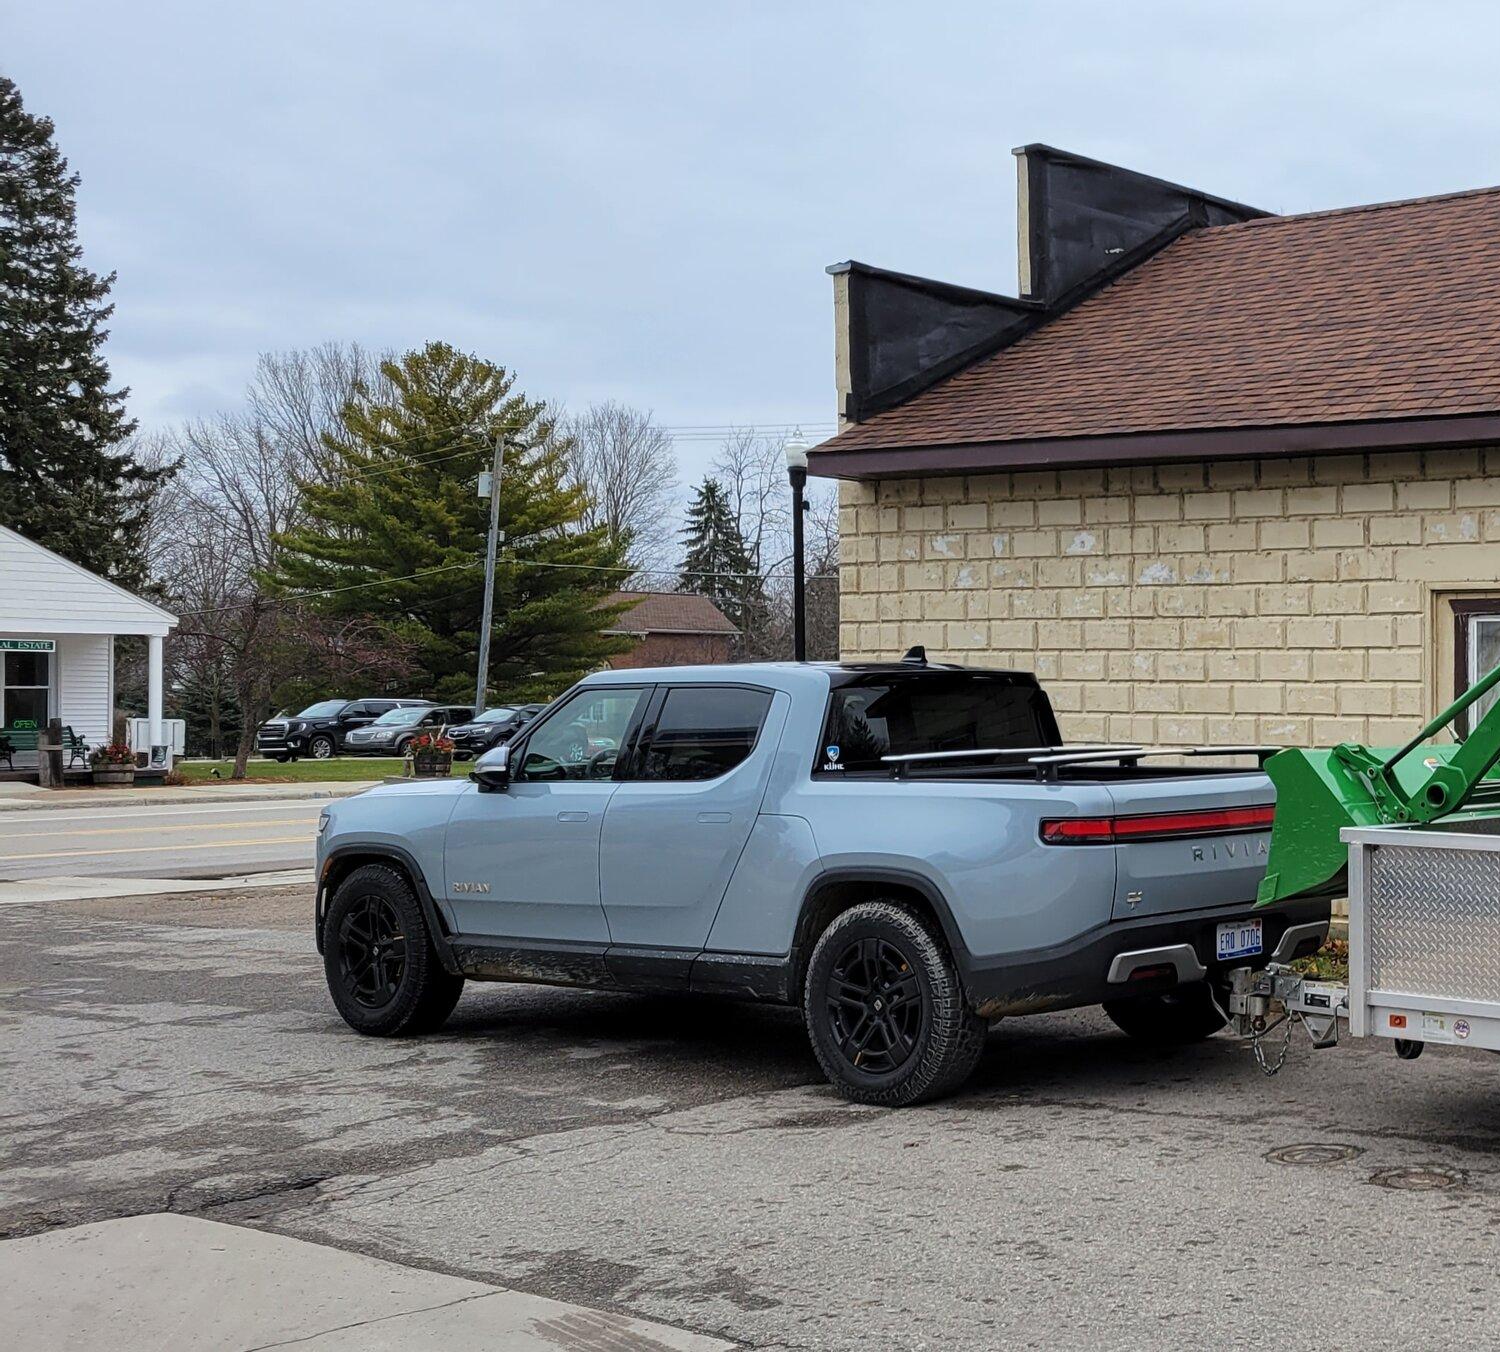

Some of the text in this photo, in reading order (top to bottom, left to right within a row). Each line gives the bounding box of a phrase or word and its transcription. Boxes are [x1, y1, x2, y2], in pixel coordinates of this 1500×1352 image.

[18, 641, 51, 650] ESTATE
[13, 719, 37, 729] OPEN
[453, 881, 491, 894] RIVIAN
[1240, 928, 1260, 947] 0706
